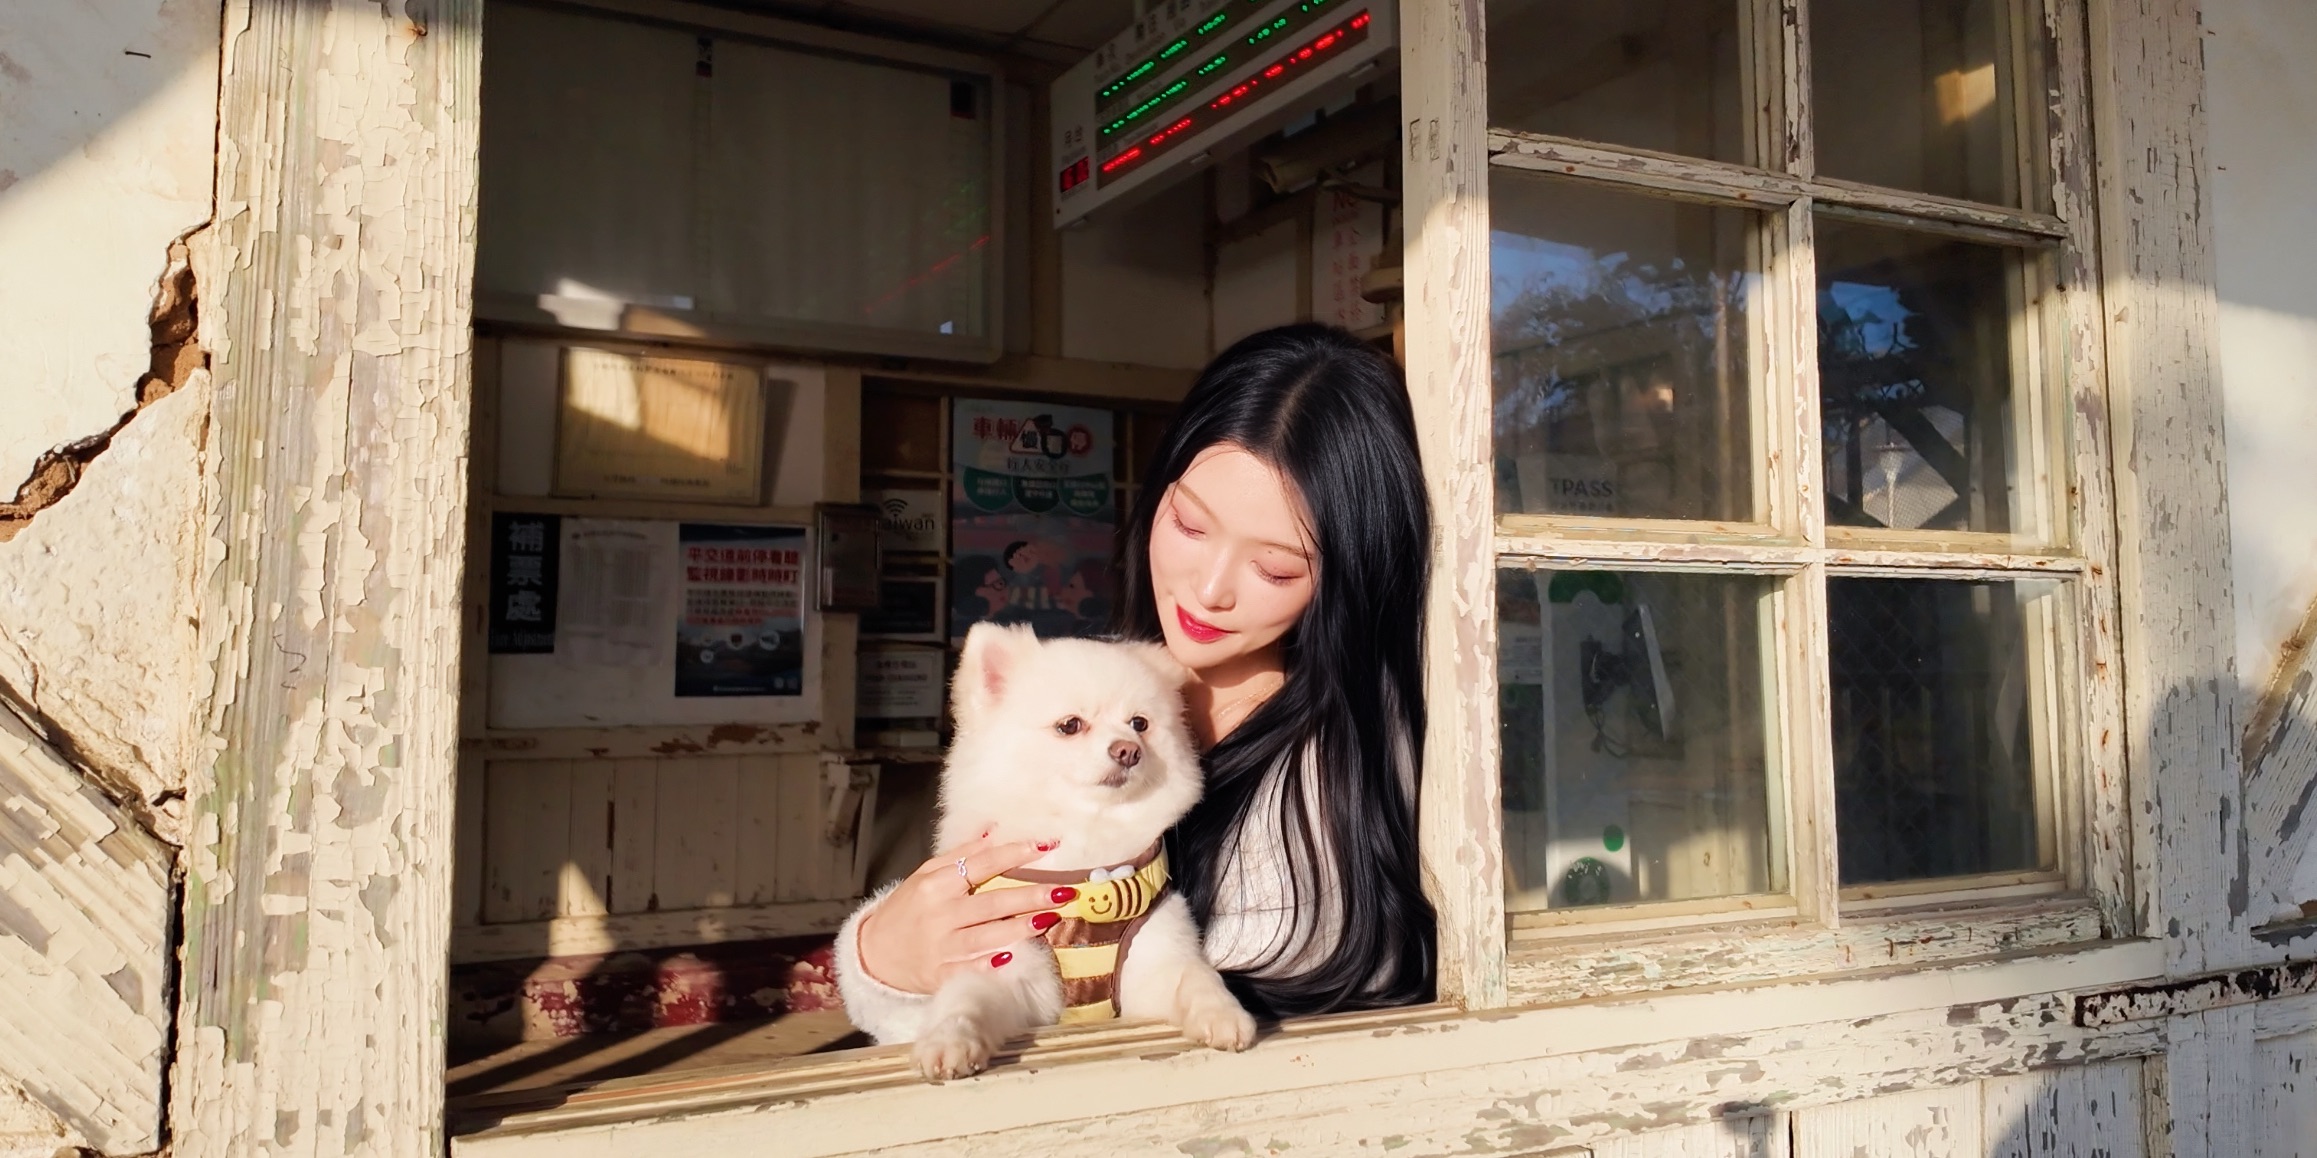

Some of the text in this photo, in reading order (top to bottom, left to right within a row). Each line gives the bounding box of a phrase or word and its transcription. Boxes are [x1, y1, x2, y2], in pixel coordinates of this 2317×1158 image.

[1548, 477, 1613, 497] TPASS
[687, 547, 799, 565] 平交道前停看聽
[505, 520, 545, 622] 補票處
